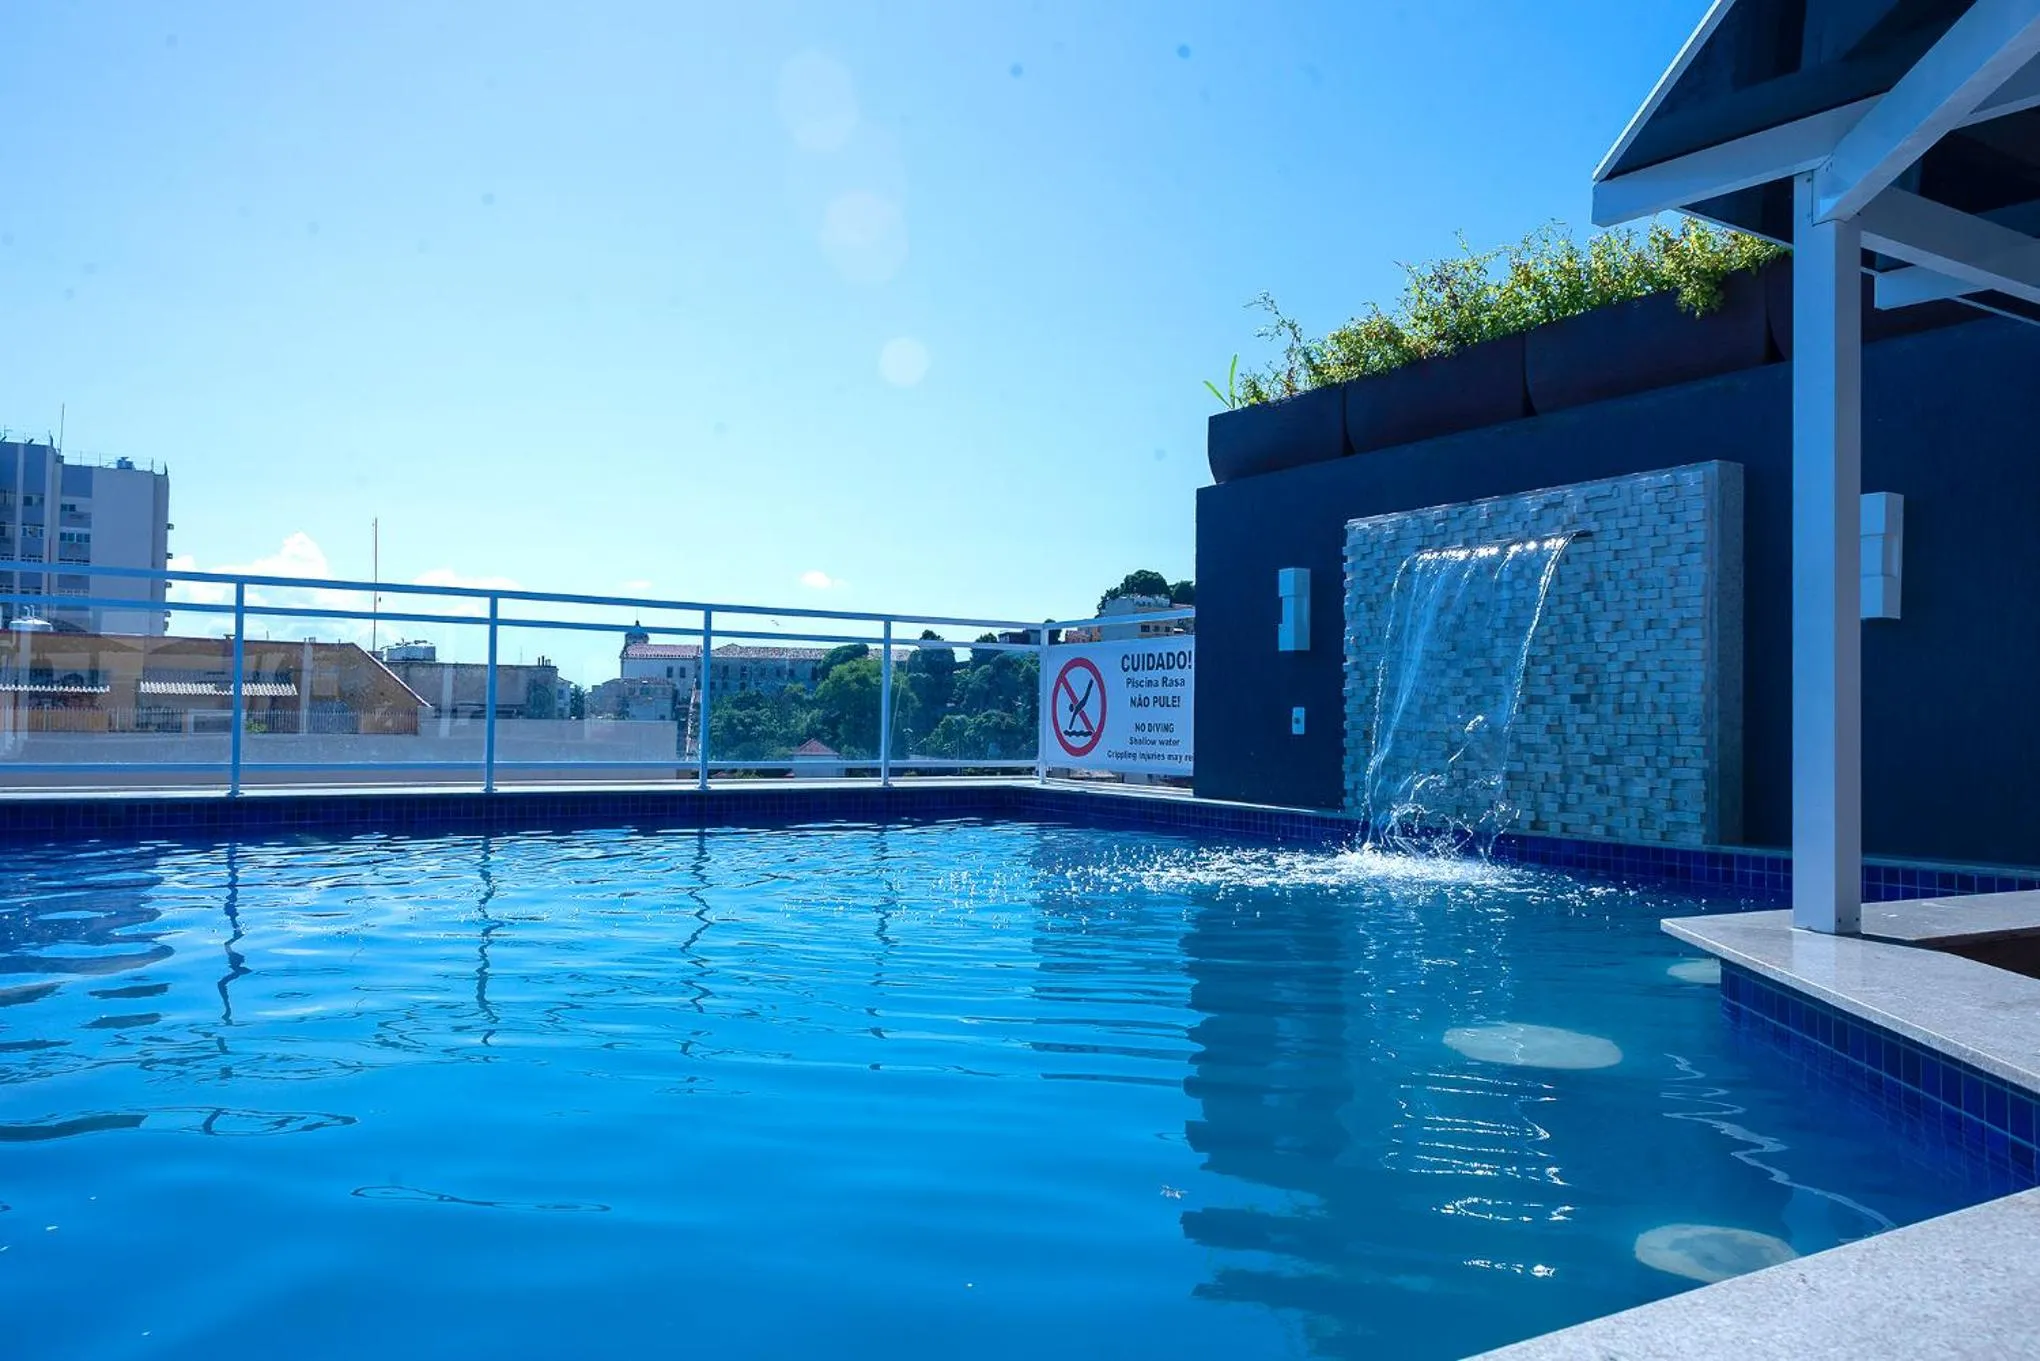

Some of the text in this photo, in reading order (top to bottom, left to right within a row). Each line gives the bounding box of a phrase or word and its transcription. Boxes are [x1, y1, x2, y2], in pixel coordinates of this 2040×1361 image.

[1121, 650, 1192, 672] CUIDADO!
[1126, 676, 1186, 689] Piscina Rasa
[1130, 694, 1181, 708] NÃO PULE!
[1135, 722, 1175, 733] NO DIVING
[1129, 736, 1180, 746] Shallow water
[1107, 750, 1138, 762] Crippling
[1166, 753, 1182, 763] may
